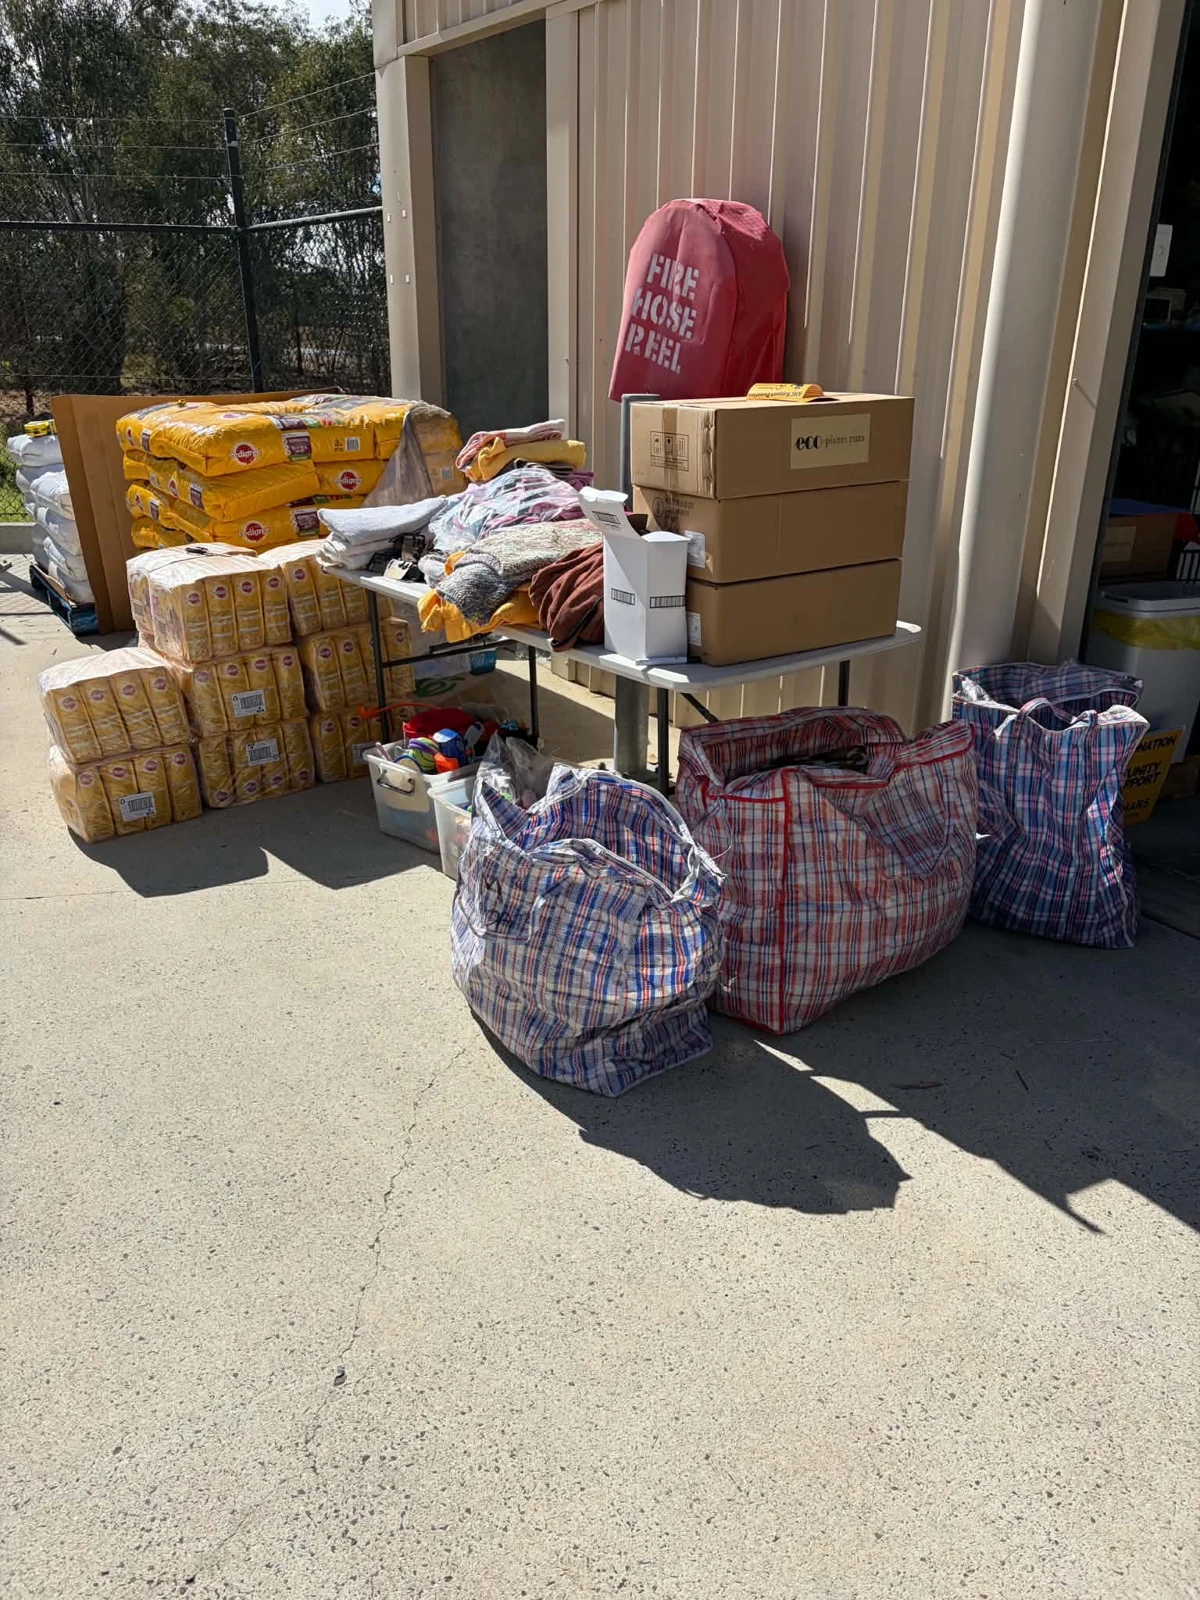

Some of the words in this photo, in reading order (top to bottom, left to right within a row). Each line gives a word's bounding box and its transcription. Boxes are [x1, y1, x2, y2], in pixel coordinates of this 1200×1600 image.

[647, 253, 700, 301] FIRE
[631, 287, 697, 339] HOSE
[624, 323, 681, 374] REEL
